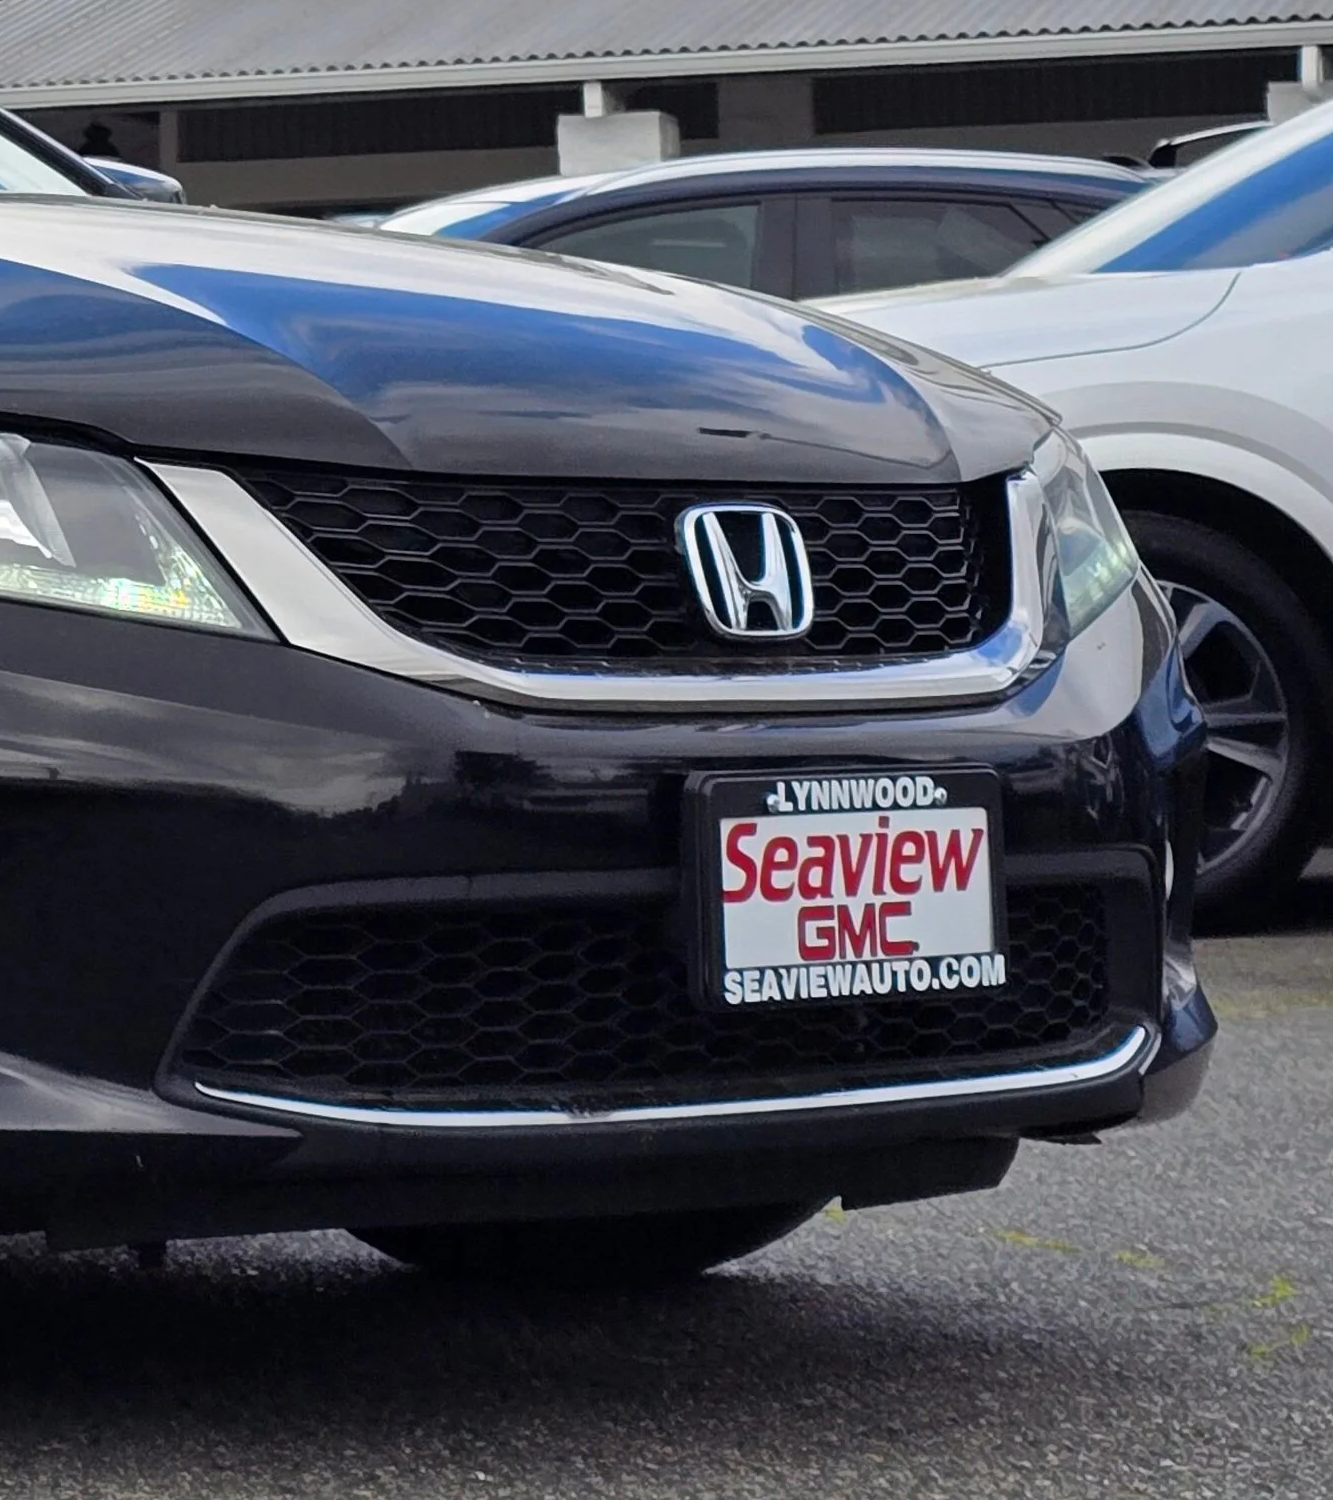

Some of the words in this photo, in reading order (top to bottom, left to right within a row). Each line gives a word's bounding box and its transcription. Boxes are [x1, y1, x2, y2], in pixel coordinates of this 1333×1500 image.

[776, 776, 934, 813] LYNNWOOD
[722, 815, 984, 904] Seaview
[797, 901, 919, 962] GMC
[723, 953, 1007, 1005] SEAVIEWAUTO.COM
